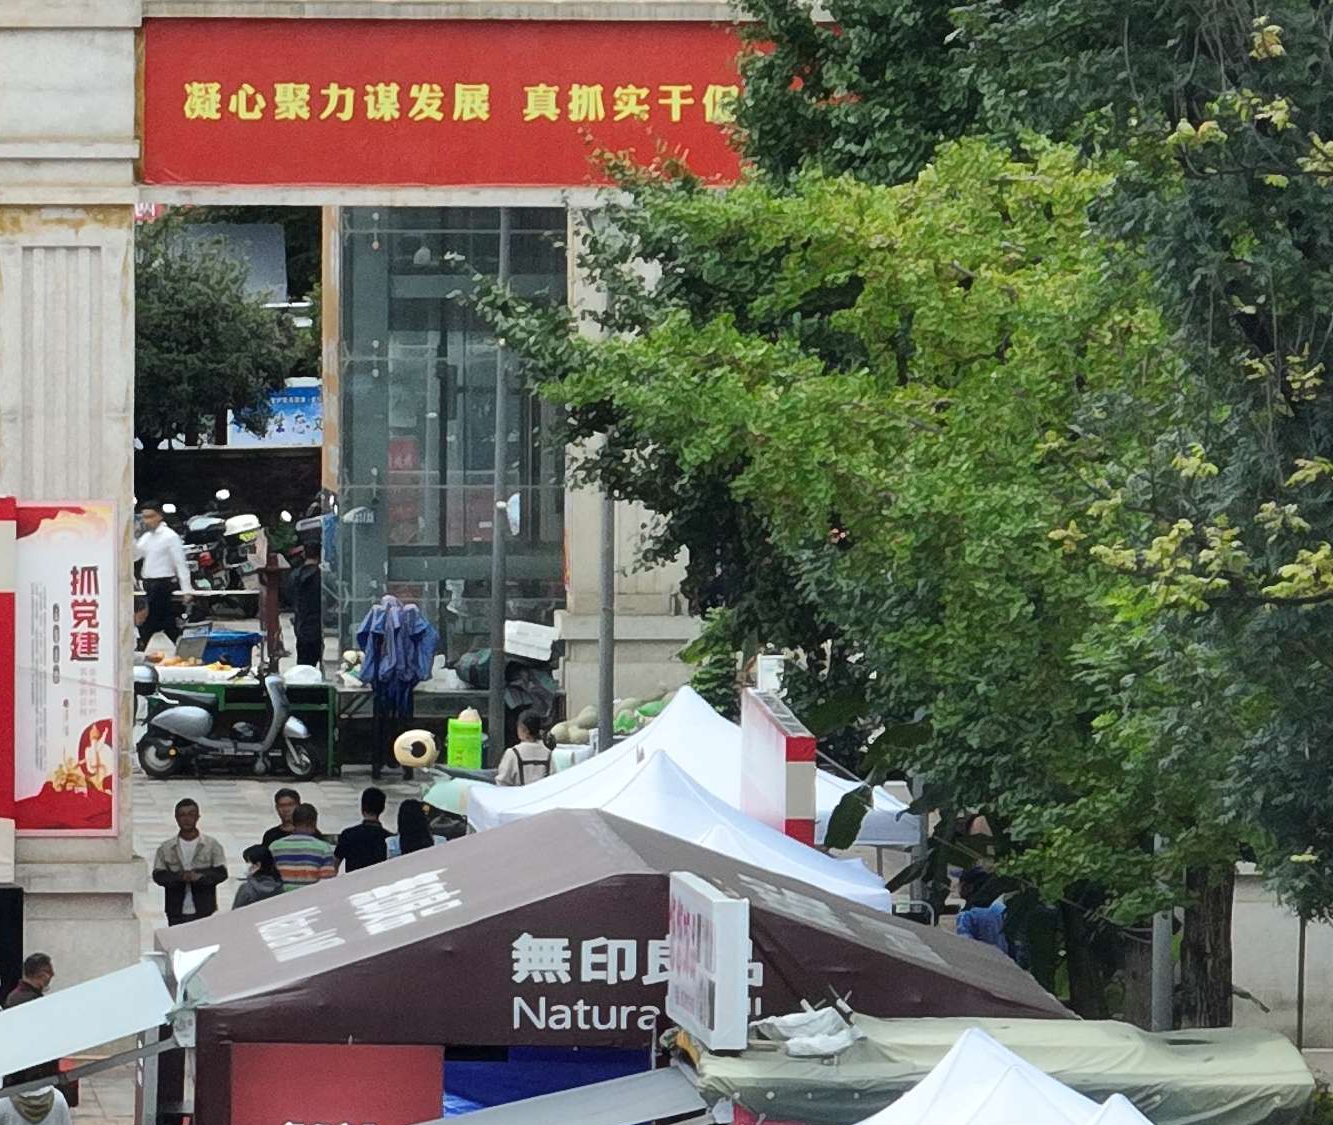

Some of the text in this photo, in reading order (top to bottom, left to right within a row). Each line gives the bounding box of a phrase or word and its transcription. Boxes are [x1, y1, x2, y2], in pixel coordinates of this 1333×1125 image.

[183, 82, 492, 122] 凝心聚力谋发展
[70, 566, 100, 661] 抓党建
